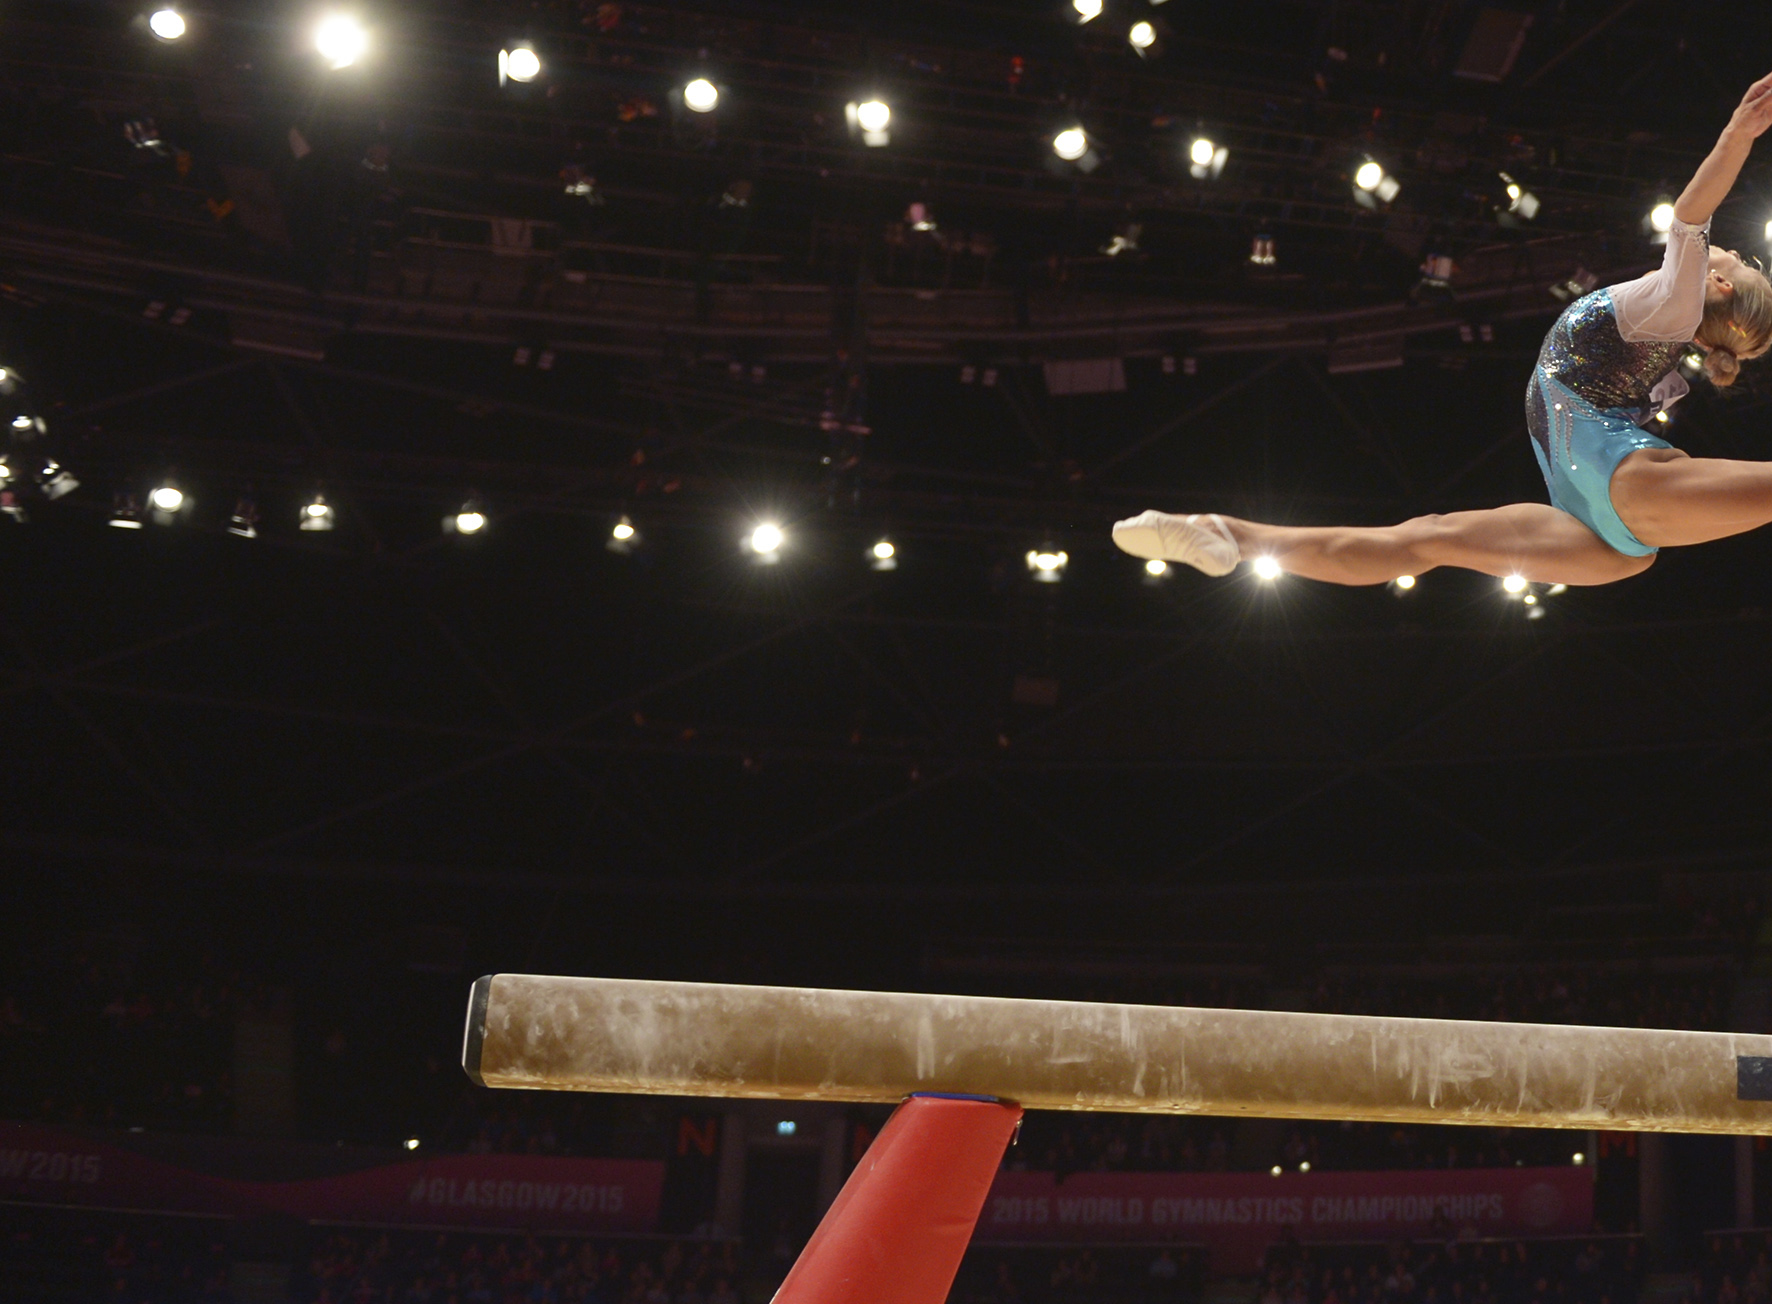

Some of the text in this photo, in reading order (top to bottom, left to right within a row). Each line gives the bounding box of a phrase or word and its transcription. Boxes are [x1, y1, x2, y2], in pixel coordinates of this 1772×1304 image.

[993, 1197, 1050, 1224] 2015
[1056, 1197, 1144, 1224] WORLD
[1151, 1197, 1302, 1224] GYMNASTICS
